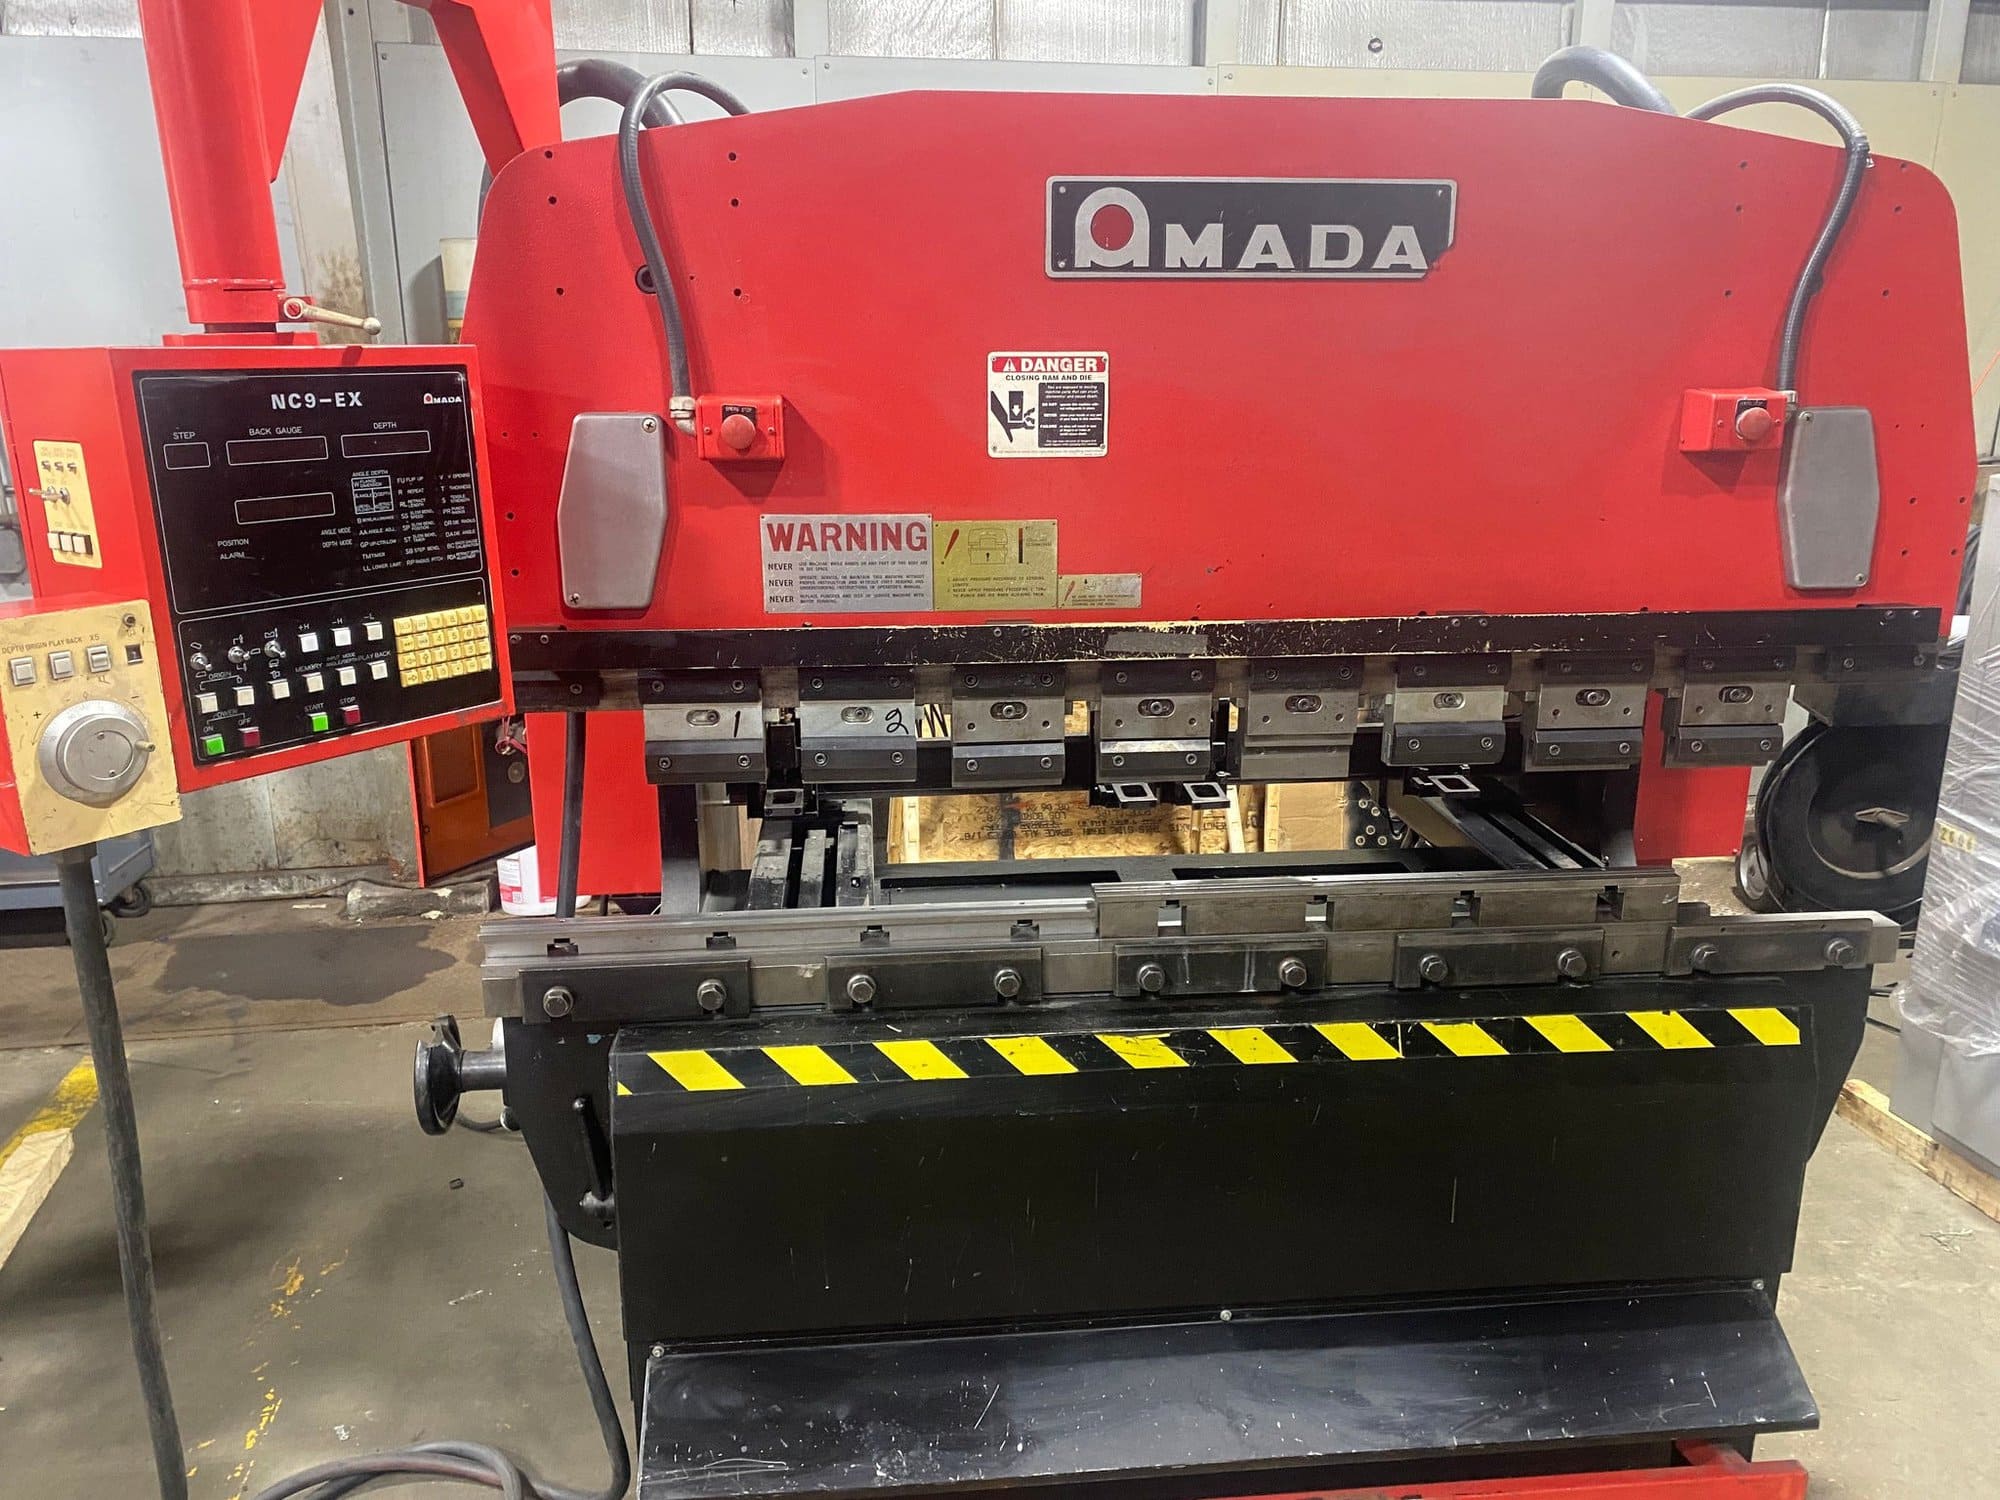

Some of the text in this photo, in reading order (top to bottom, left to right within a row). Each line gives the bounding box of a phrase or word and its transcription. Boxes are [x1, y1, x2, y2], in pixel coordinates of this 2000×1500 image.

[1074, 186, 1429, 269] AMADA
[1020, 357, 1097, 372] DANGER
[271, 391, 363, 410] NC9-EX
[373, 421, 397, 430] DEPTH
[173, 431, 196, 440] STEP
[249, 426, 302, 436] BACK GAUGE
[320, 528, 337, 536] ANGLE
[766, 522, 928, 552] WARNING
[217, 538, 249, 547] POSITION
[220, 551, 245, 560] ALARM
[768, 562, 793, 570] NEVER
[769, 579, 793, 587] NEVER
[769, 595, 794, 603] NEVER
[2, 644, 25, 655] DEPTH
[25, 641, 47, 650] ORIGIN
[48, 638, 65, 648] PLAY
[65, 637, 83, 645] BACK
[358, 650, 391, 661] PLAY BACK
[295, 662, 323, 673] MEMORY
[208, 672, 231, 680] ORIGIN
[340, 696, 356, 705] STOP
[304, 702, 324, 711] START
[238, 717, 251, 726] OFF
[734, 710, 741, 738] 1
[885, 708, 909, 735] 2
